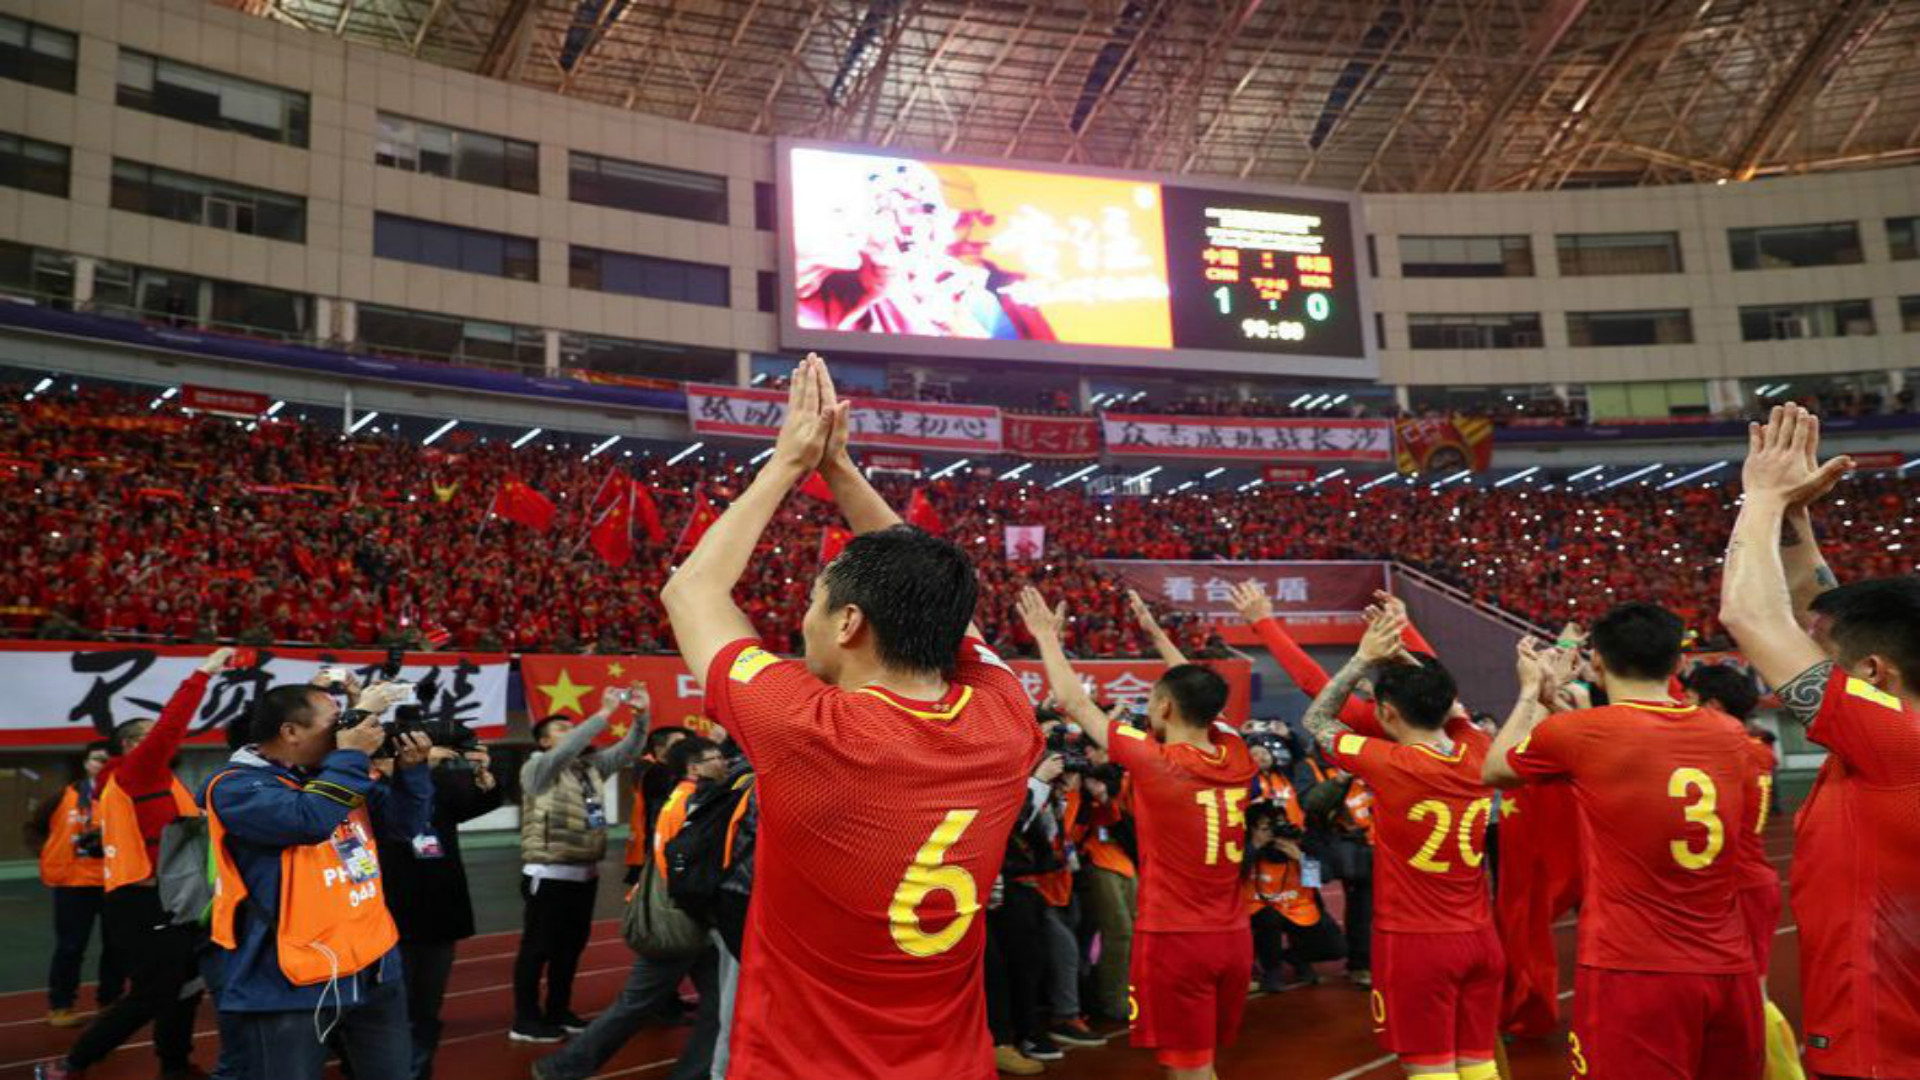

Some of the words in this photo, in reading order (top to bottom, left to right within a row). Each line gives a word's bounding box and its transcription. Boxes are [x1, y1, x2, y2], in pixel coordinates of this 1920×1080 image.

[1214, 286, 1231, 314] 1
[1306, 292, 1329, 321] 0
[1196, 788, 1248, 864] 15
[1407, 797, 1490, 873] 20
[1668, 767, 1724, 870] 3
[889, 809, 981, 957] 6
